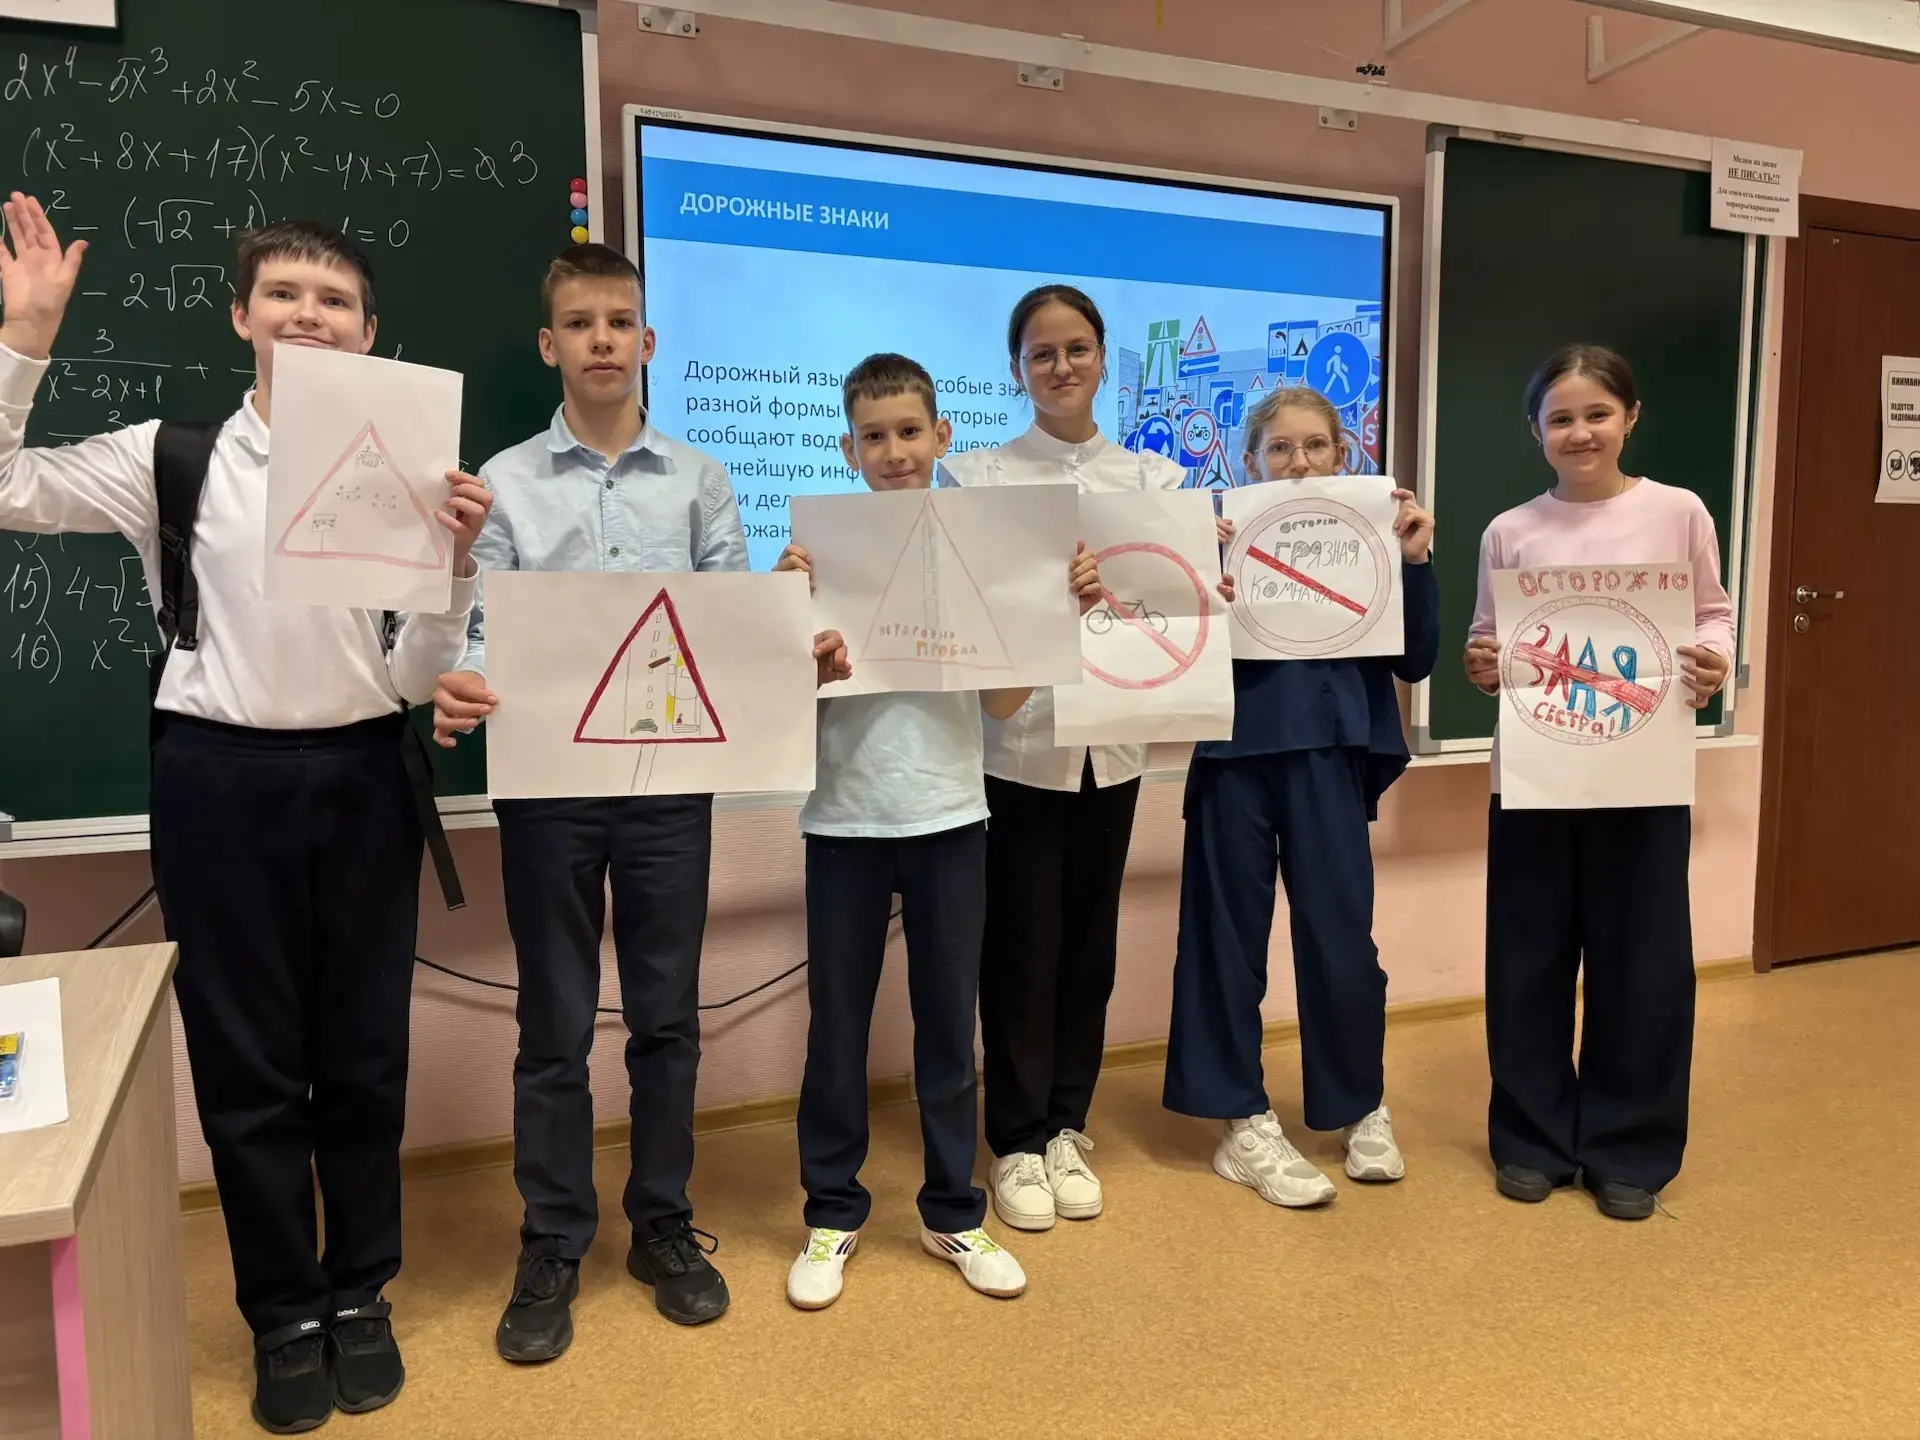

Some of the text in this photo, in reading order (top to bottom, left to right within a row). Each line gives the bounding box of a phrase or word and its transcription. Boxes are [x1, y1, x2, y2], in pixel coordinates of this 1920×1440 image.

[1728, 167, 1781, 184] НЕ ПИСАТЬ!!!
[680, 191, 889, 230] ДОРОЖНЫЕ ЗНАКИ
[684, 360, 800, 385] Дорожный
[807, 371, 845, 387] язы
[934, 376, 993, 395] собые
[1891, 377, 1920, 387] ВНИМАНИ
[686, 396, 1008, 427] разной формы оторые
[1890, 402, 1914, 411] ВЕДЕТСЯ
[686, 426, 795, 449] сообщают
[821, 466, 860, 484] инф
[756, 494, 791, 511] дел
[1274, 539, 1360, 570] ГРЯЗНАЯ
[1517, 568, 1689, 597] ОСТОРОЖНО
